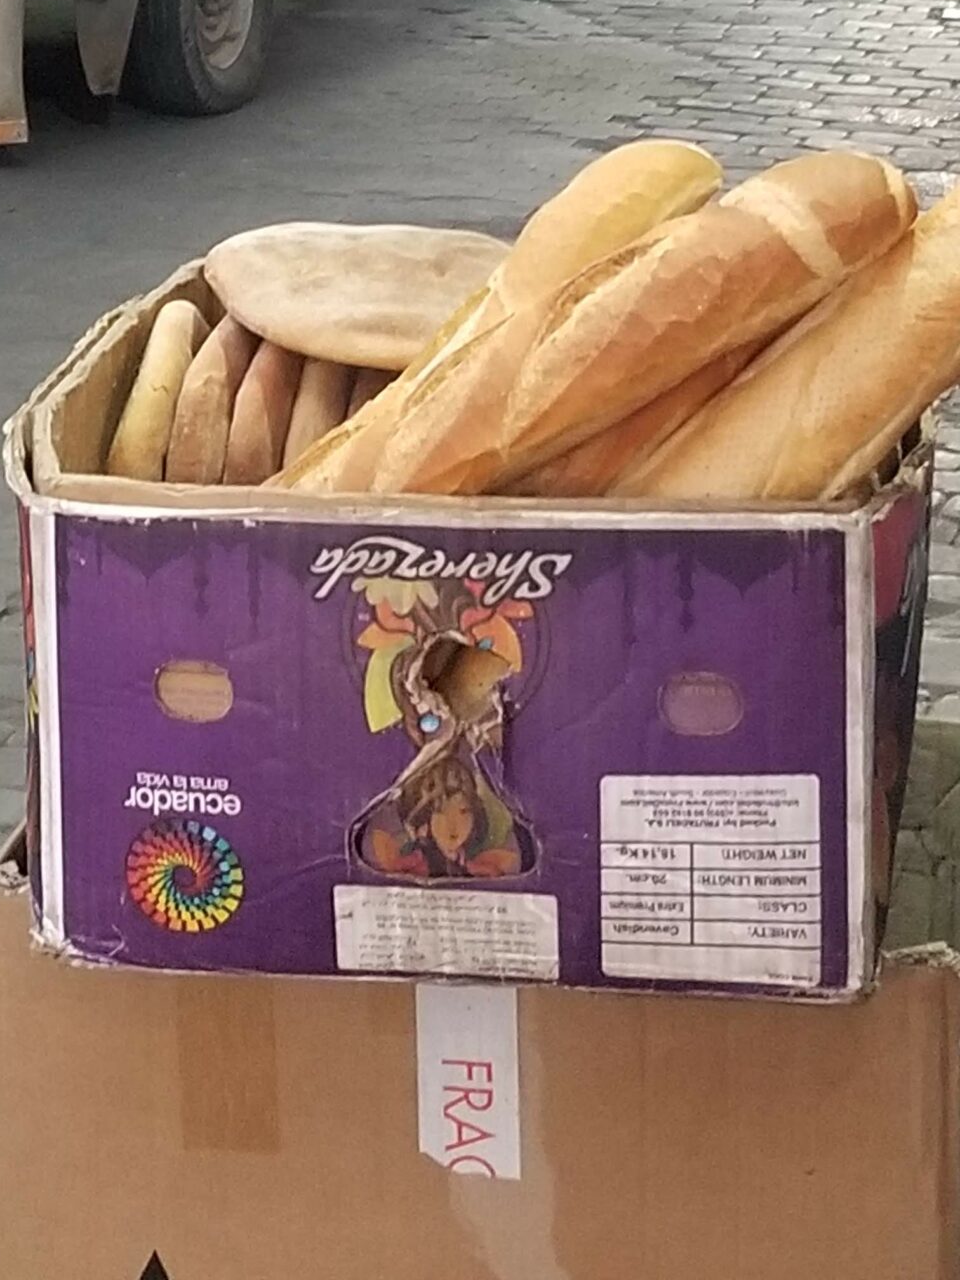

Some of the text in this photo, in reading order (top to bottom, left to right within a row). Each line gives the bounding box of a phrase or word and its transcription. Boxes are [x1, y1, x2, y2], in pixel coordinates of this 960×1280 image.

[310, 536, 572, 606] Sherezada
[136, 772, 228, 791] ama la vida
[124, 786, 241, 816] ecuador
[780, 849, 807, 861] NET
[754, 875, 807, 887] MINIMUM
[613, 923, 680, 937] Cavendish
